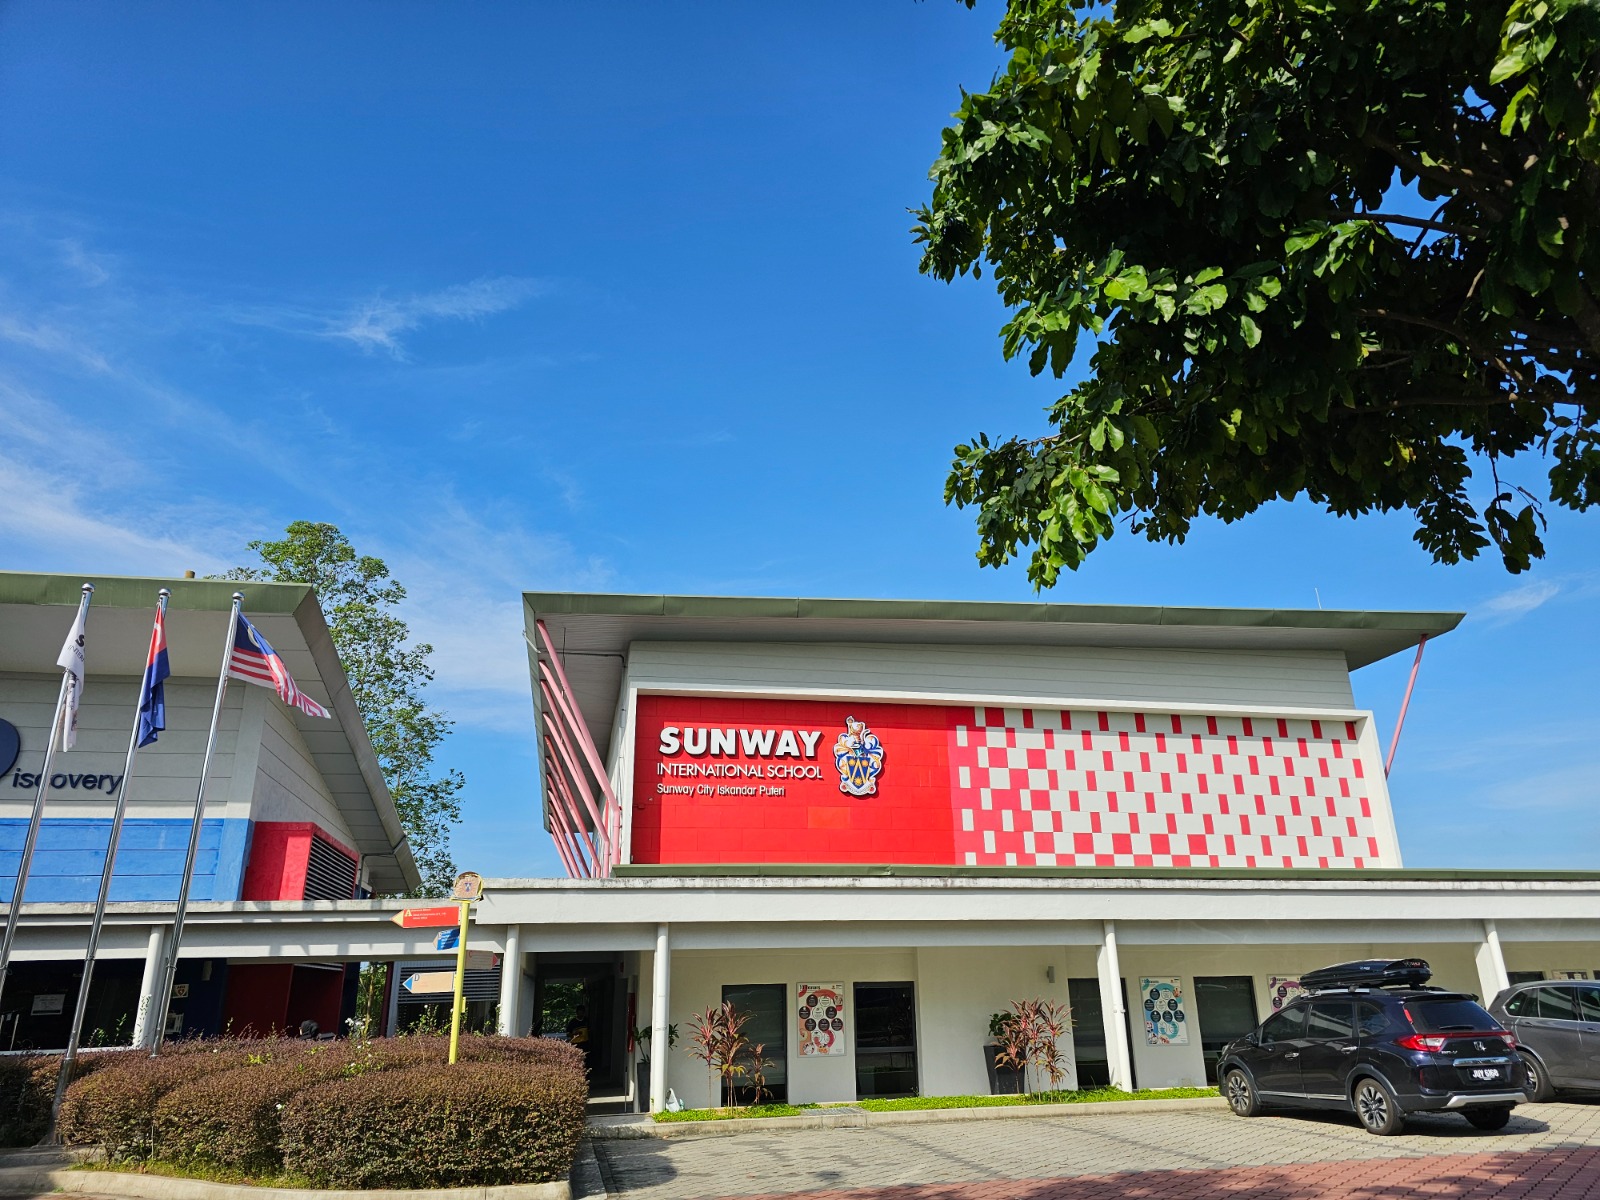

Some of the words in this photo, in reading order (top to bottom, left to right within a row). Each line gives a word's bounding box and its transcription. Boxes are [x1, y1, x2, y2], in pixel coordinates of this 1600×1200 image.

[659, 726, 821, 757] SUNWAY
[657, 762, 764, 778] INTERNATIONAL
[767, 764, 823, 779] SCHOOL
[656, 783, 694, 796] Sunway
[697, 784, 714, 797] City
[717, 784, 756, 796] Iskandar
[759, 785, 785, 796] Puteri
